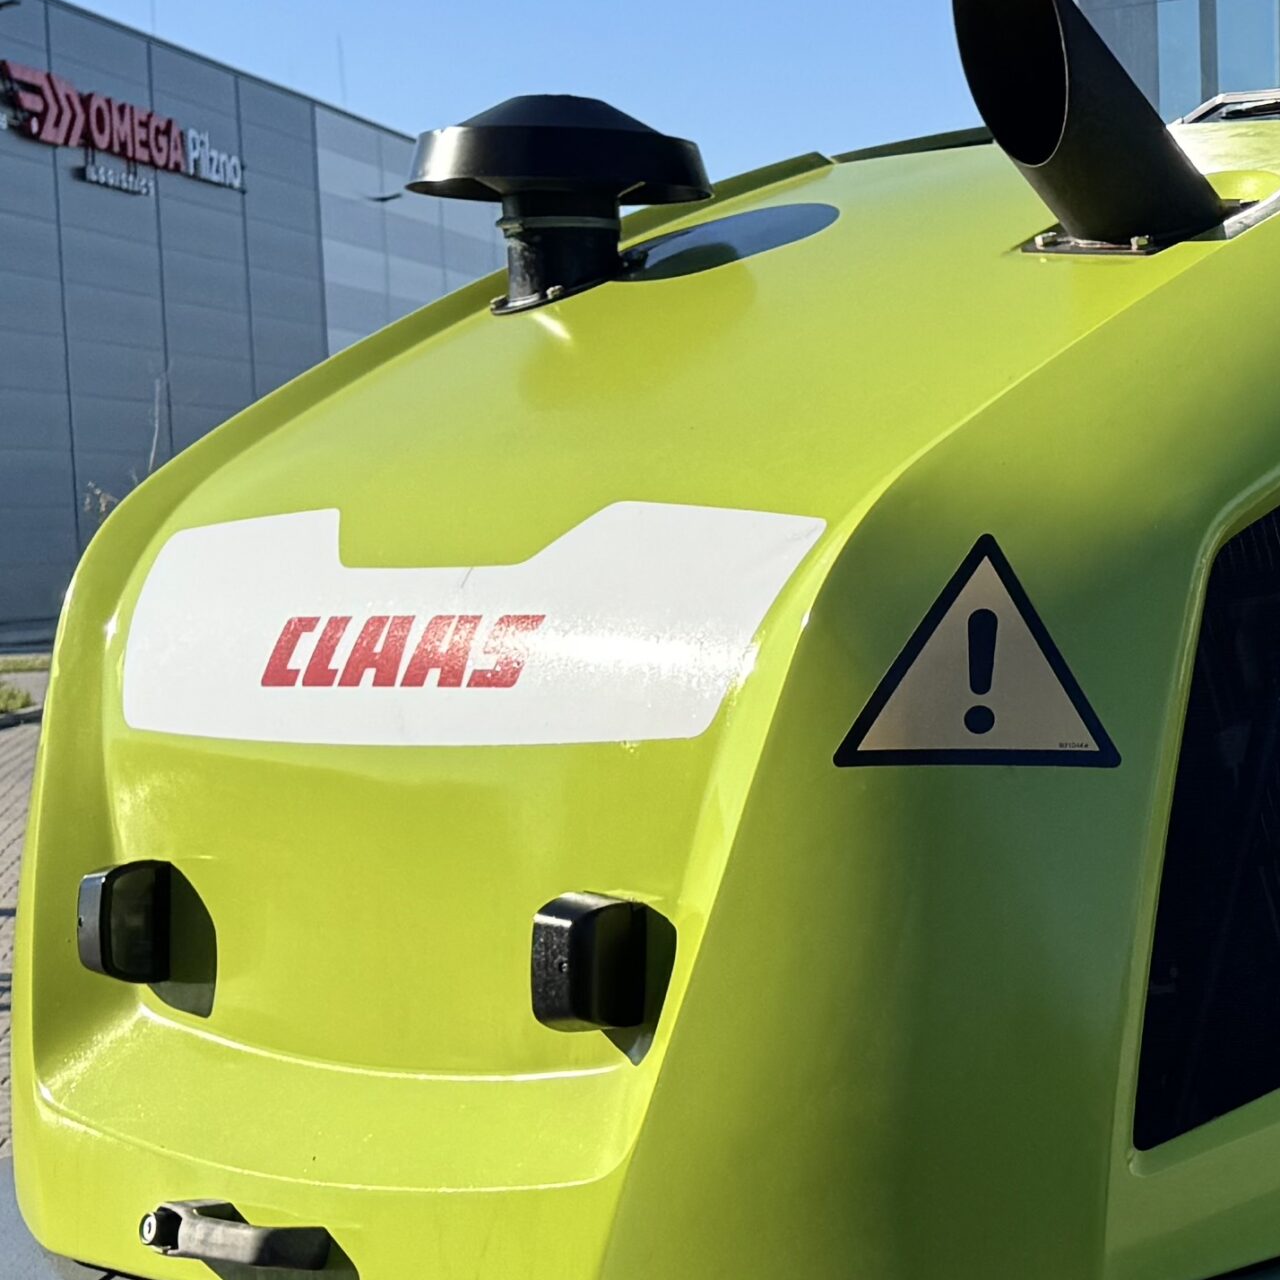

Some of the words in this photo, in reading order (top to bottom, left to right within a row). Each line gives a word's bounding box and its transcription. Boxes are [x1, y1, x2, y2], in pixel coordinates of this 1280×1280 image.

[89, 91, 186, 171] OMEGA
[187, 127, 243, 189] Pilzno
[260, 614, 547, 688] CLAAS
